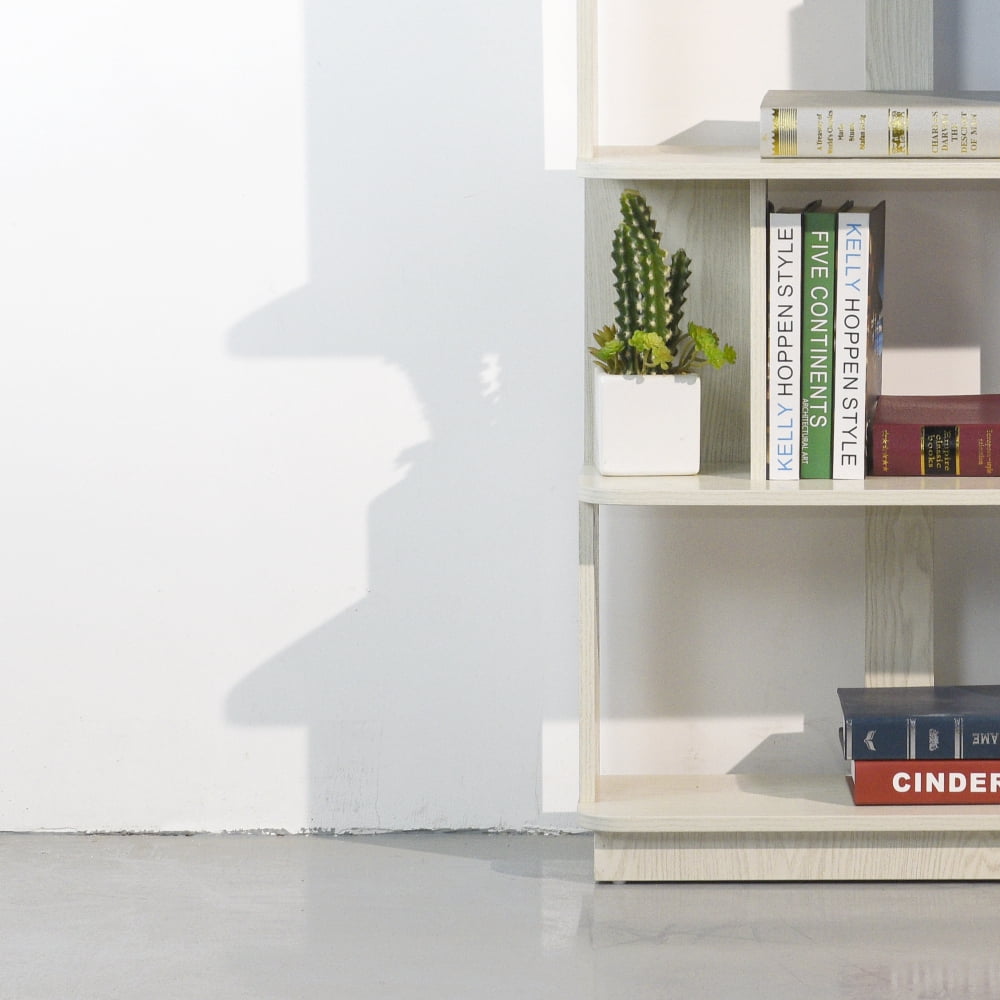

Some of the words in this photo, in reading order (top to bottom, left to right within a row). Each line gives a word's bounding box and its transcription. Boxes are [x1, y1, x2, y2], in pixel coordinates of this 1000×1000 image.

[777, 228, 793, 297] STYLE
[811, 231, 829, 279] FIVE
[845, 223, 861, 291] KELLY
[777, 305, 793, 396] HOPPEN
[809, 286, 828, 427] CONTINENTS
[843, 299, 860, 390] HOPPEN
[777, 403, 793, 471] KELLY
[801, 398, 809, 451] ARCHITECTURAL
[801, 451, 809, 465] ART
[841, 397, 858, 466] STYLE
